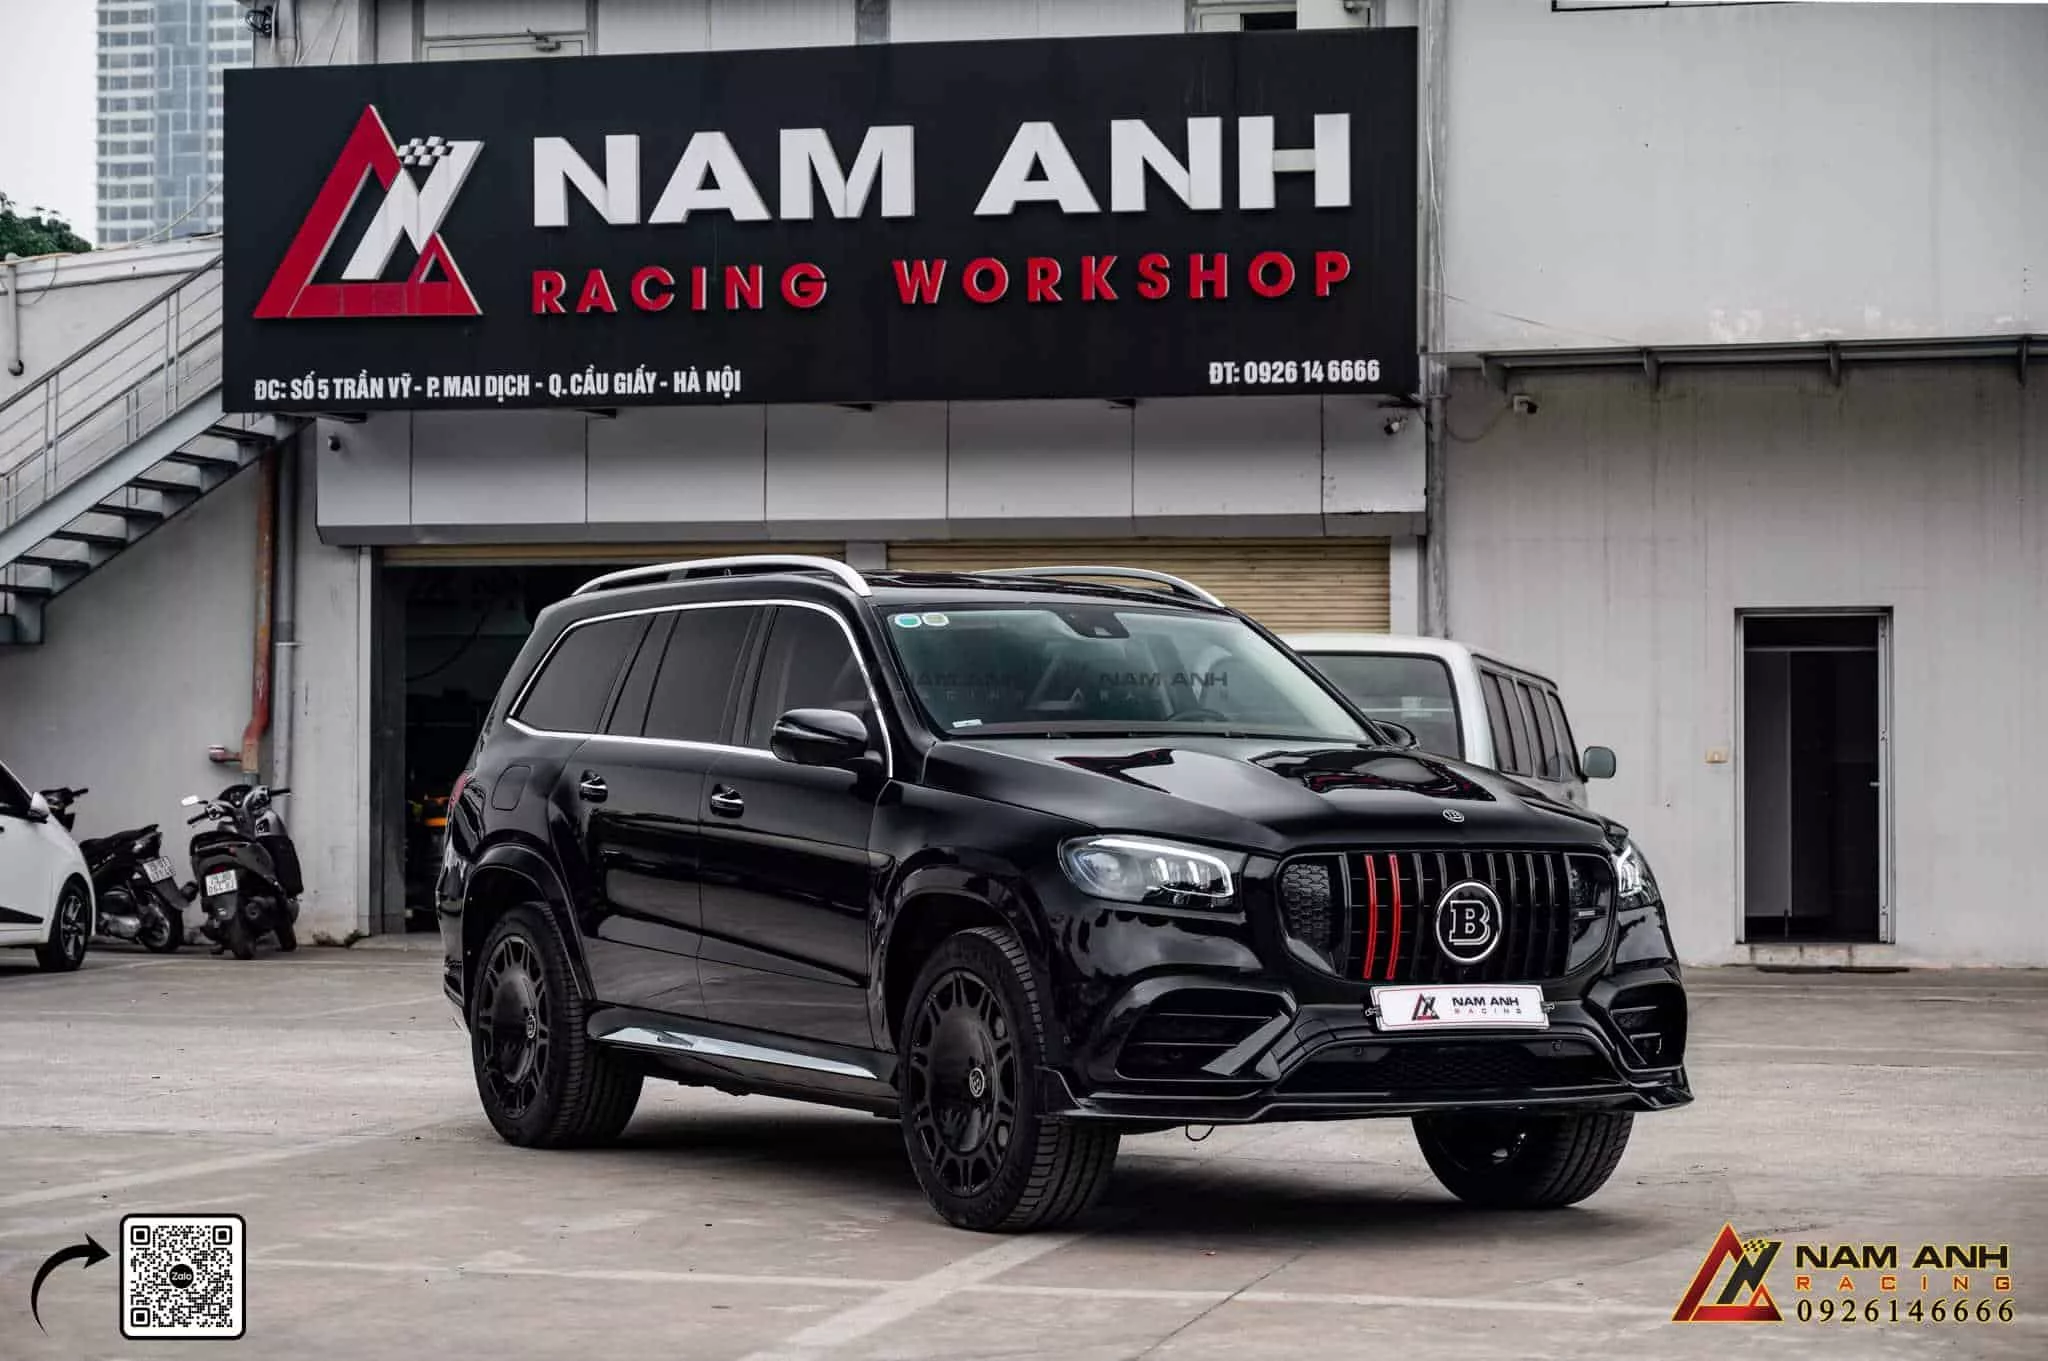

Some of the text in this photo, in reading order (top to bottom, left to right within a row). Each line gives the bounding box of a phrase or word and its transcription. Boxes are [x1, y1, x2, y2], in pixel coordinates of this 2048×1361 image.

[533, 112, 1351, 226] NAM ANH
[532, 249, 1352, 316] RACING WORKSHOP
[254, 379, 287, 401] ĐC:
[290, 369, 315, 401] SỐ
[317, 378, 329, 400] 5
[332, 368, 384, 400] TRẦN
[484, 373, 530, 403] DỊCH
[613, 363, 657, 395] GIẤY
[673, 365, 701, 393] HÀ
[706, 364, 741, 399] NỘI
[1208, 359, 1381, 385] ĐT: 0926 14 6666
[1452, 996, 1520, 1006] NAM ANH
